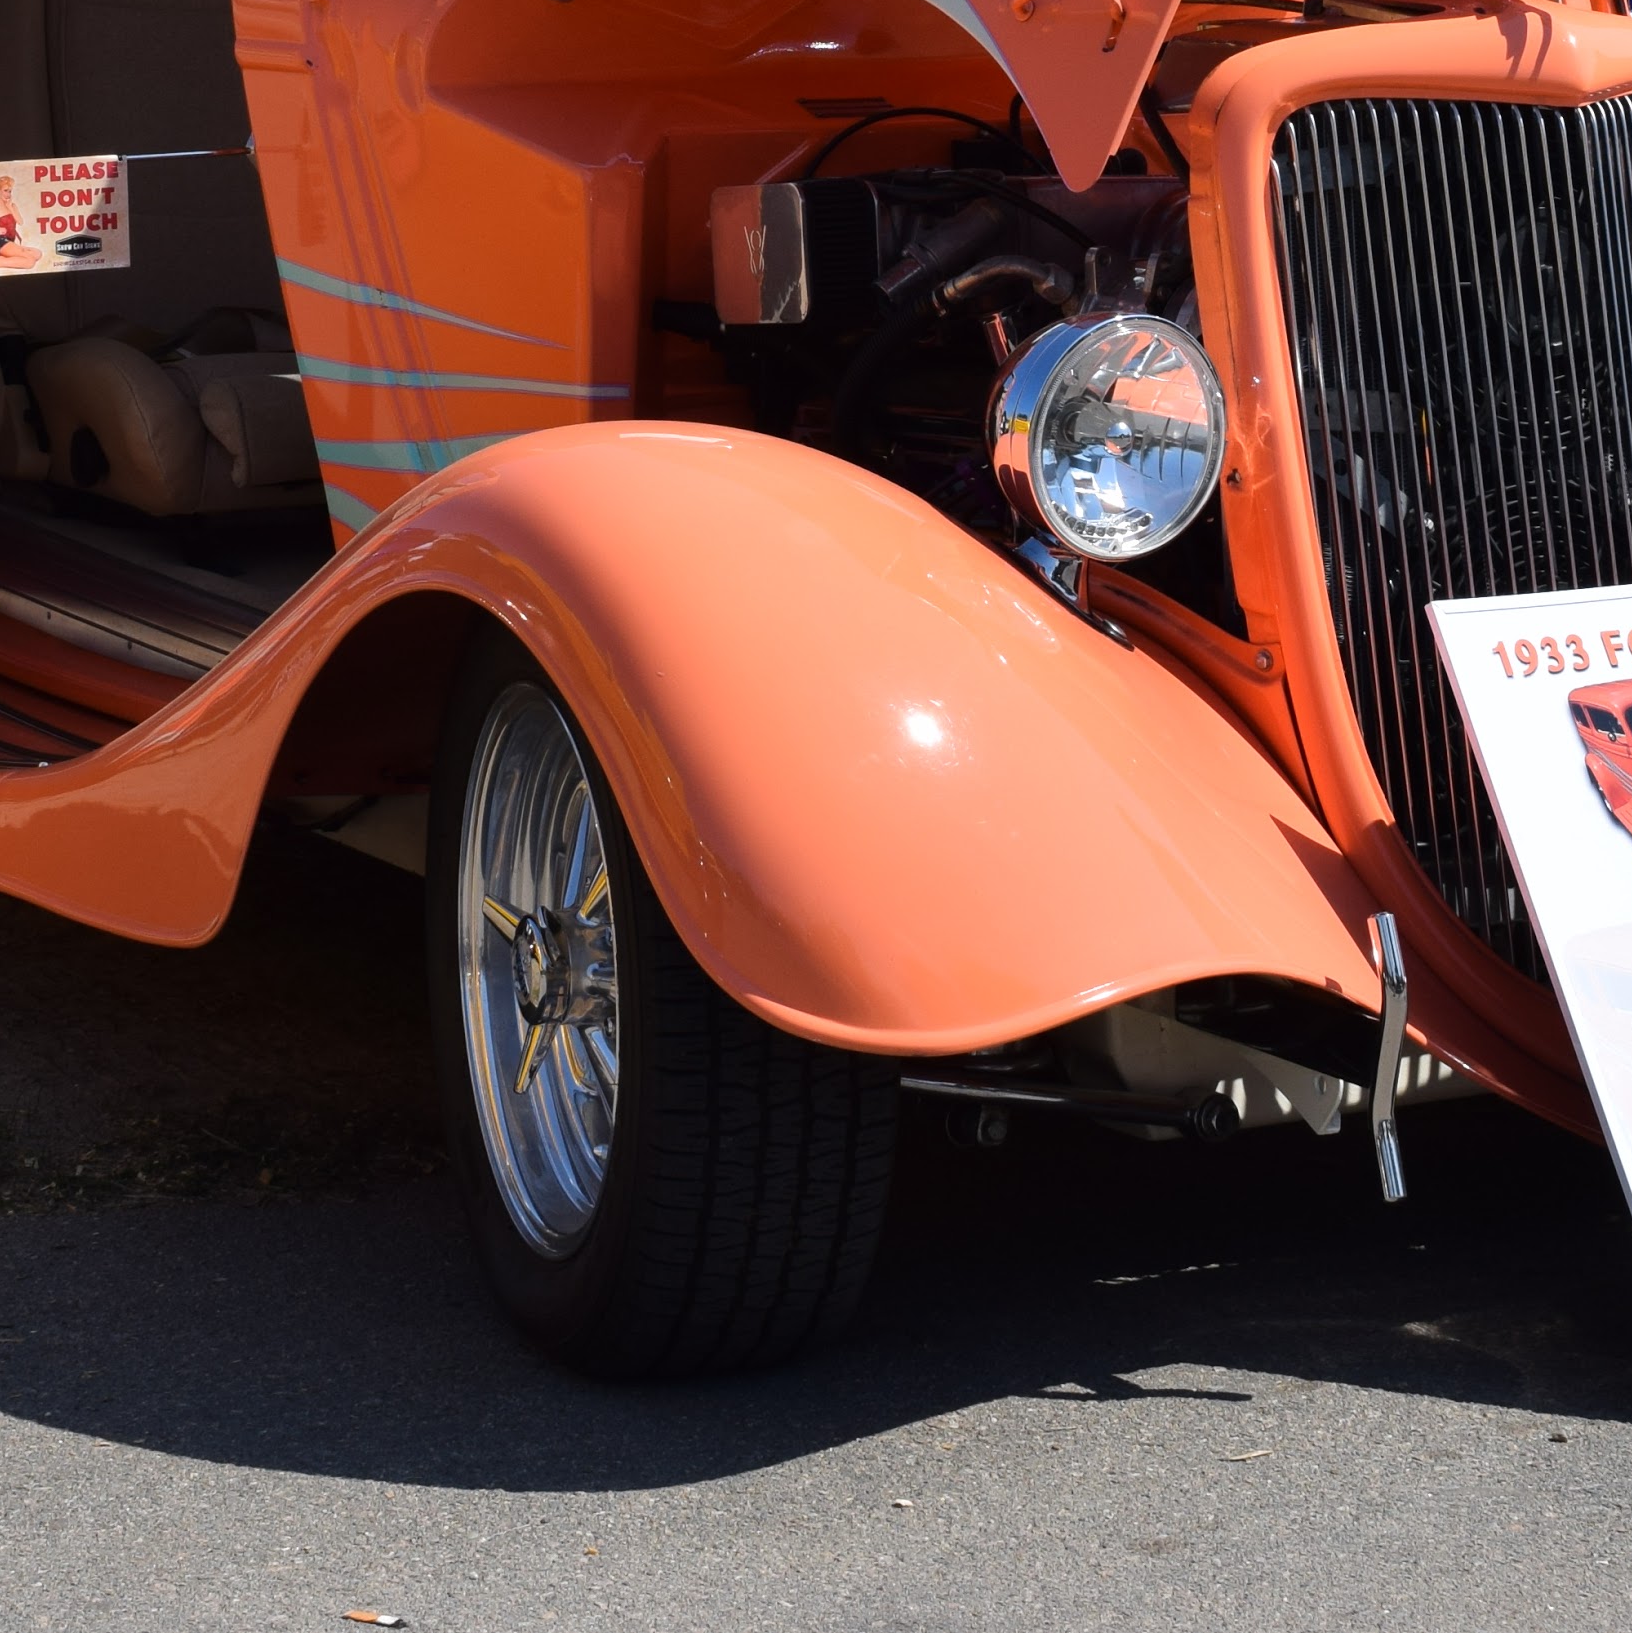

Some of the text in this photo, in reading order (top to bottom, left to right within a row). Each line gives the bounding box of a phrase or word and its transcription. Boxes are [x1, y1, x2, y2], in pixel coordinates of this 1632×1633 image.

[34, 161, 119, 184] PLEASE
[40, 187, 115, 208] DON'T
[36, 212, 118, 235] TOUCH
[1492, 633, 1591, 680] 1933
